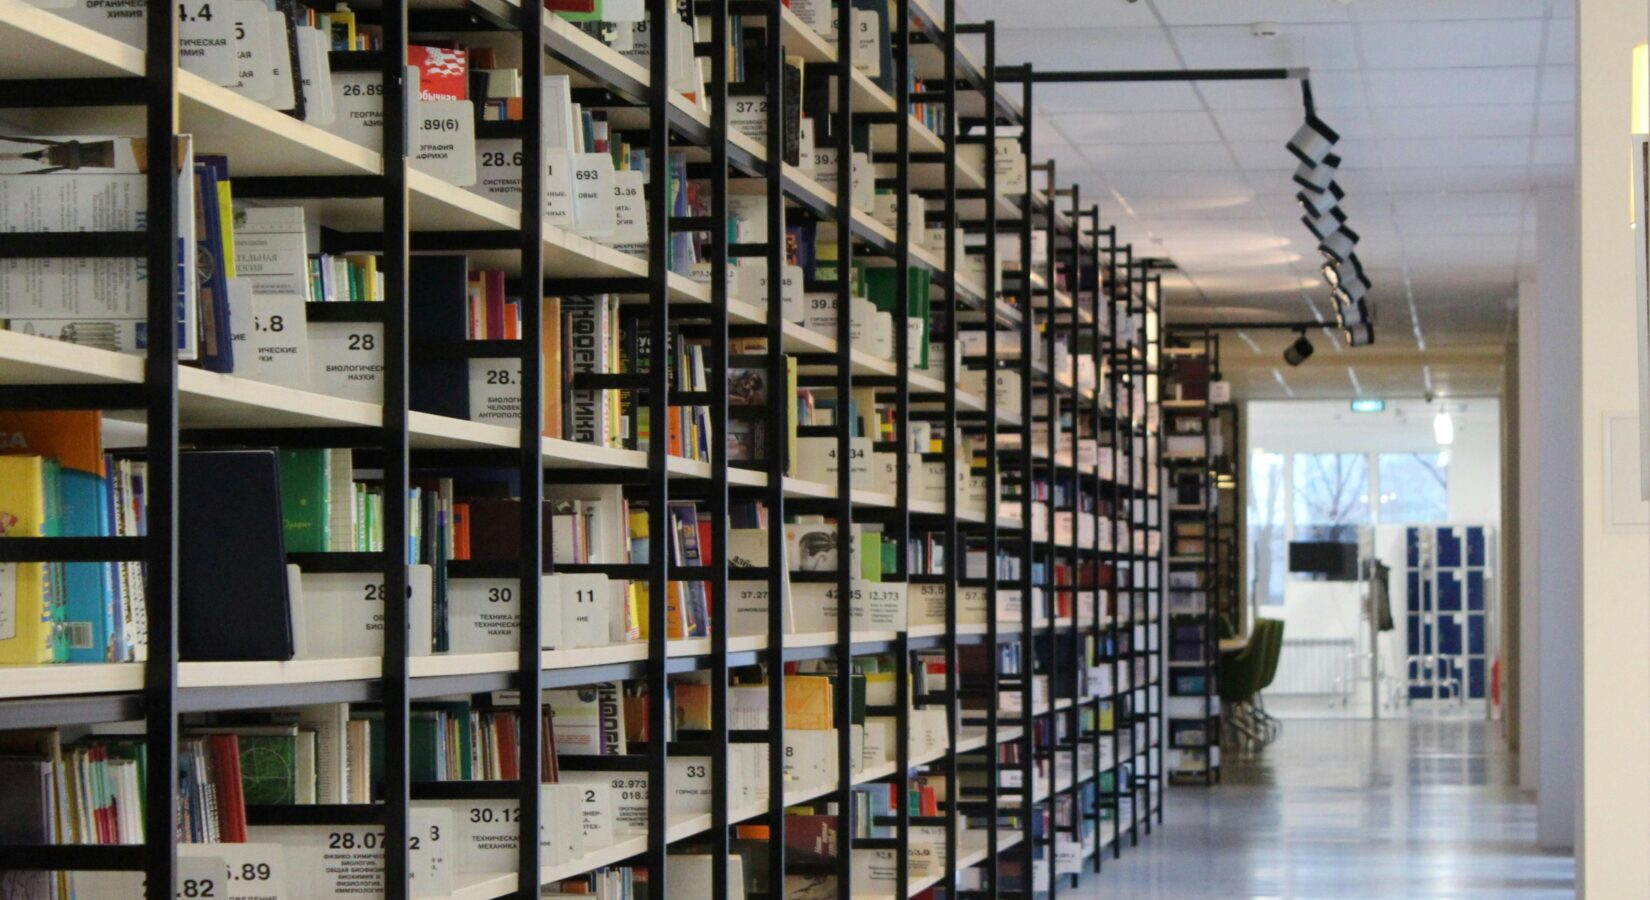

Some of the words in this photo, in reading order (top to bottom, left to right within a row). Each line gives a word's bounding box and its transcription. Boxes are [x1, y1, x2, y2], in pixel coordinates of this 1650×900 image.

[107, 9, 143, 18] ХИМИЯ
[482, 151, 522, 168] 28.6
[576, 170, 600, 181] 693
[348, 334, 375, 351] 28
[573, 294, 596, 442] ИНФОРМТИКА
[347, 373, 376, 382] НАУКИ
[488, 587, 512, 603] 30
[575, 589, 595, 603] 11
[686, 765, 706, 777] 33
[470, 807, 521, 823] 30.12
[328, 832, 386, 850] 28.07
